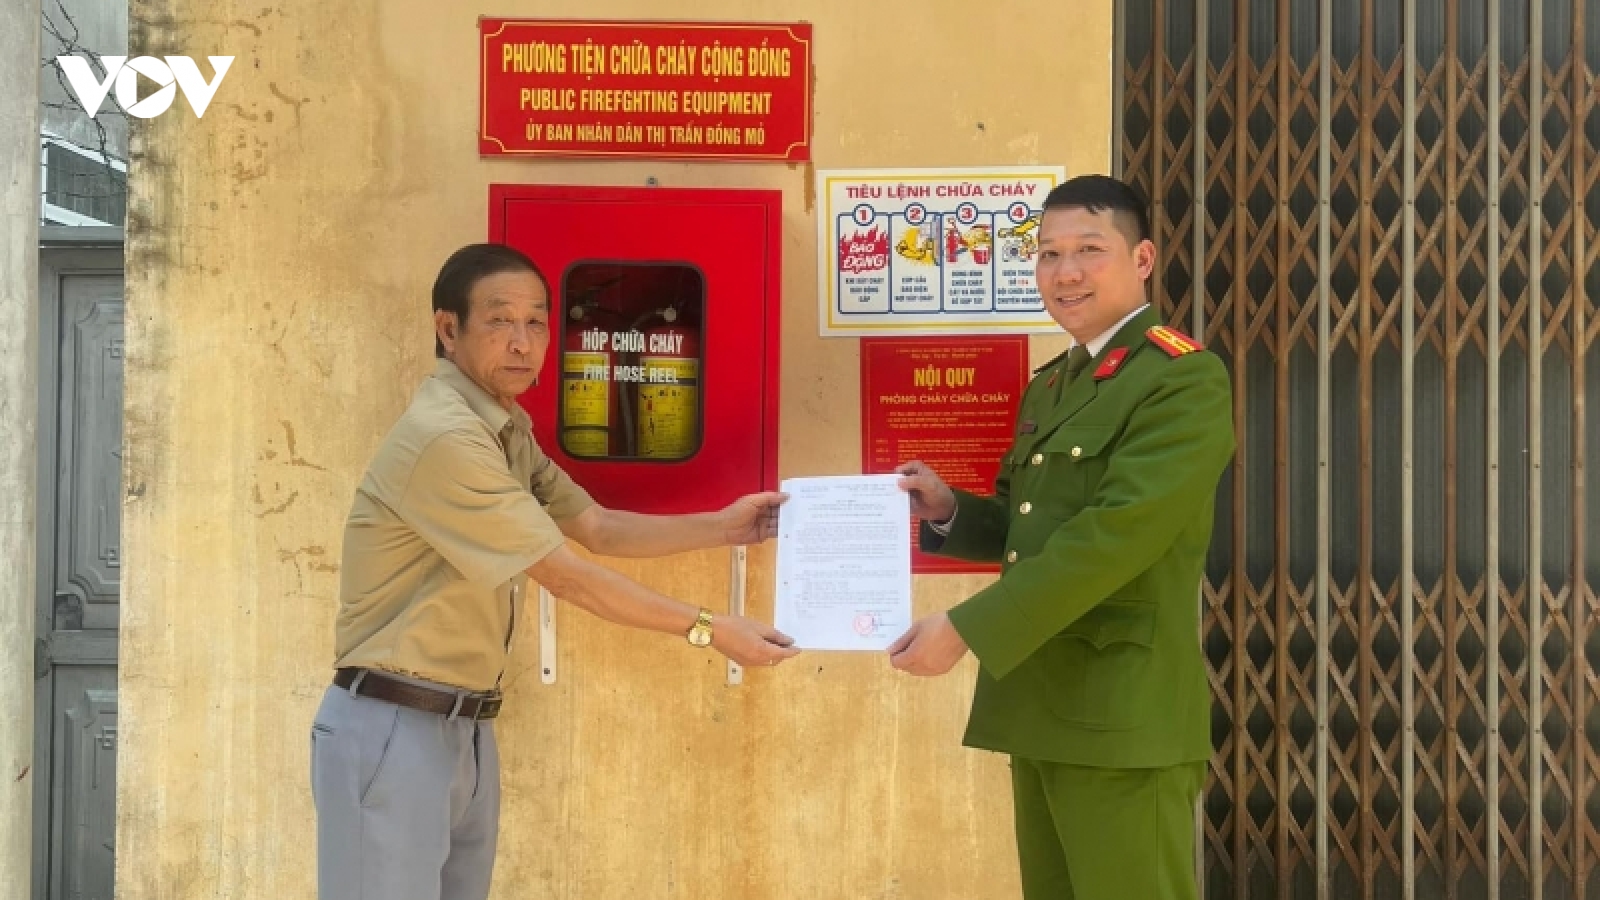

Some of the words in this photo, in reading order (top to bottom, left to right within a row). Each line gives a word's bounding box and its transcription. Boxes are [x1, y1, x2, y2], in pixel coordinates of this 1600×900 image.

[502, 41, 567, 73] PHƯƠNG
[571, 37, 605, 81] TIỆN
[609, 39, 651, 75] CHỮA
[655, 39, 697, 75] CHÁY
[701, 38, 743, 82] CỘNG
[520, 87, 576, 111] PUBLIC
[580, 89, 678, 113] FIREFGHTING
[683, 91, 773, 116] EQUIPMENT
[545, 123, 573, 141] BAN
[576, 121, 613, 143] NHÂN
[646, 125, 666, 146] THỊ
[845, 183, 882, 199] TIÊU
[887, 183, 931, 201] LỆNH
[935, 182, 984, 198] CHỮA
[989, 181, 1037, 196] CHÁY
[859, 209, 868, 222] 1
[910, 208, 921, 221] 2
[962, 208, 973, 220] 3
[1013, 206, 1025, 219] 4
[611, 328, 647, 353] CHỮA
[649, 329, 684, 354] CHÁY
[583, 364, 611, 382] FIRE
[613, 365, 647, 383] HOSE
[649, 366, 679, 384] REEL
[913, 363, 942, 391] NỘI
[945, 367, 976, 389] QUY
